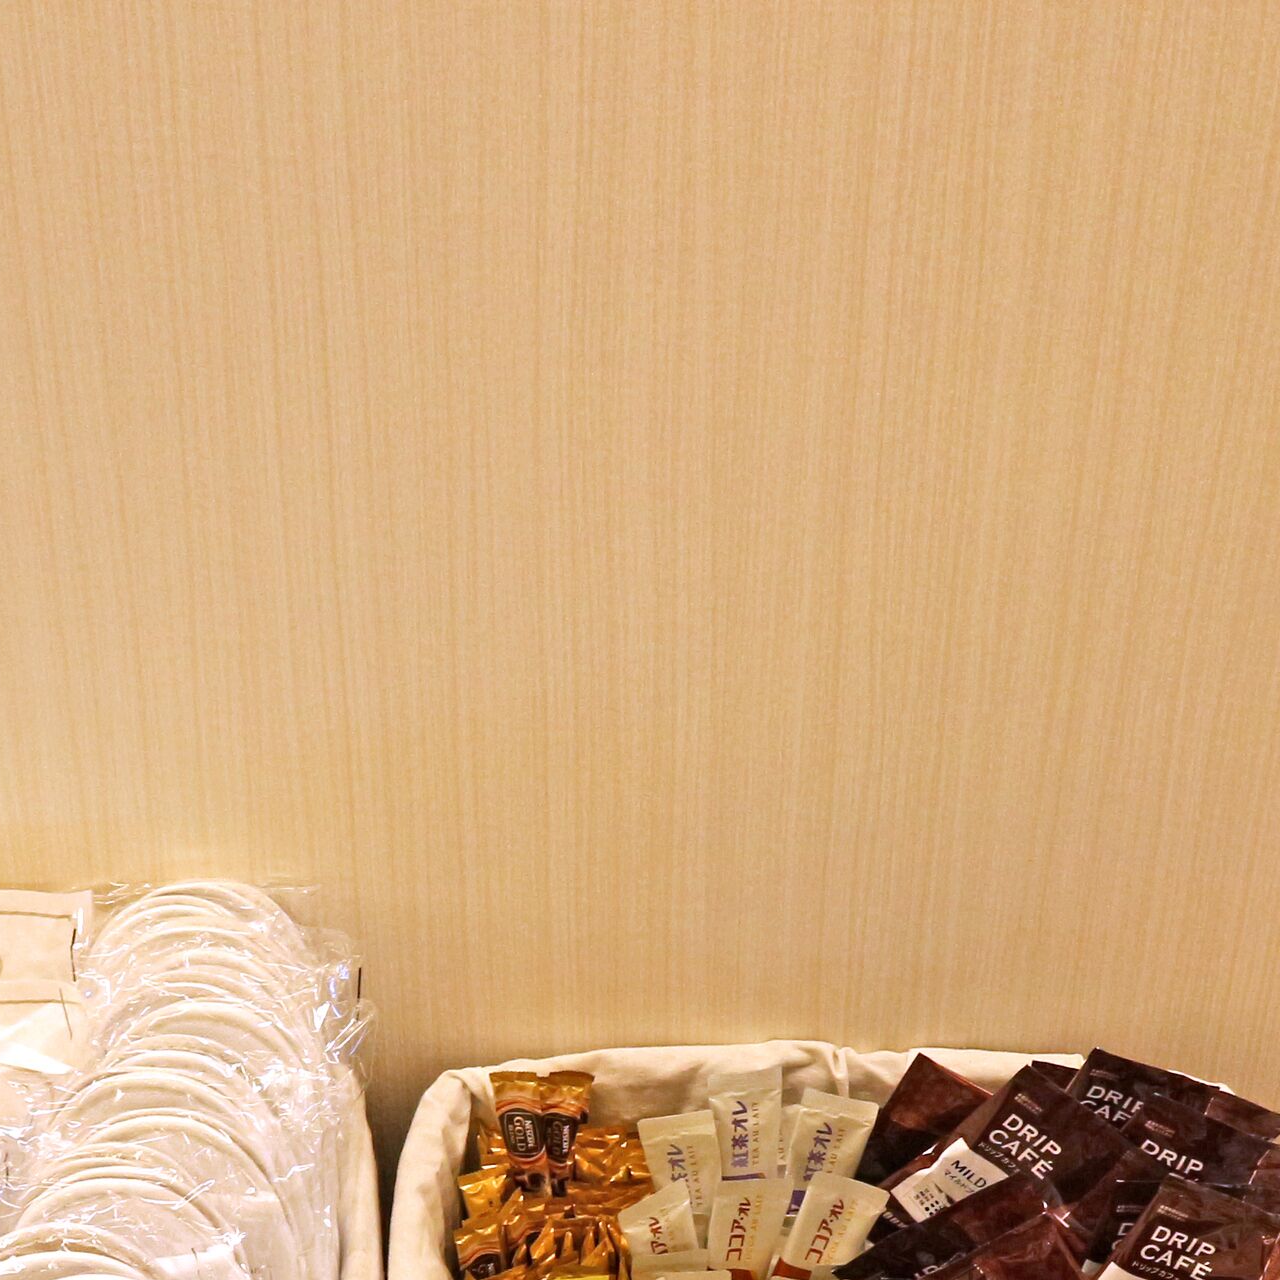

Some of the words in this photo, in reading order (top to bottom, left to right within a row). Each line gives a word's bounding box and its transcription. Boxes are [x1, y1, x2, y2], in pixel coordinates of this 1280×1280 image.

[513, 1116, 526, 1152] GOLD
[731, 1100, 749, 1169] 紅茶オレ
[1002, 1113, 1063, 1156] DRIP
[988, 1129, 1055, 1180] CAFÉ
[1140, 1139, 1204, 1175] DRIP
[951, 1159, 987, 1188] MILD
[1150, 1225, 1217, 1258] DRIP
